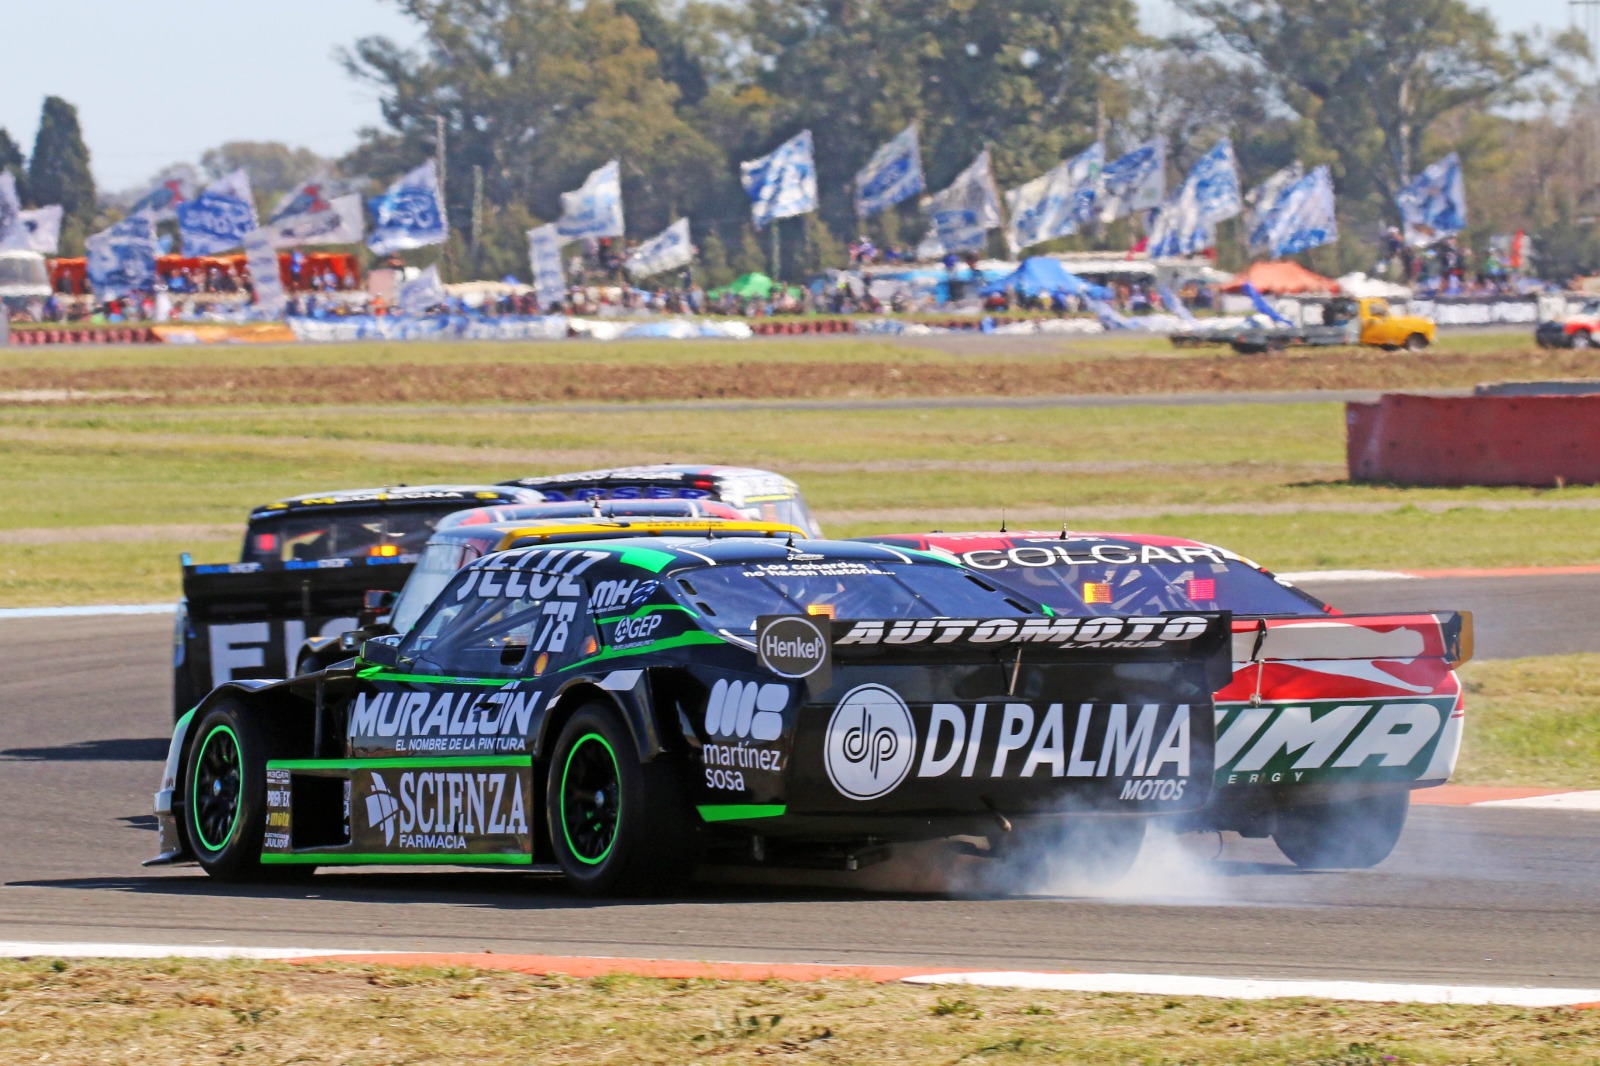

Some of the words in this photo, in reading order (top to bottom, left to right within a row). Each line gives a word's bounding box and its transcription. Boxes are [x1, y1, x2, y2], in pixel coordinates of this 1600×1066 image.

[756, 563, 789, 571] Los
[791, 561, 867, 571] cobardes
[962, 545, 1225, 570] COLCAR
[456, 549, 611, 601] JELUZ
[742, 570, 765, 578] no
[770, 568, 819, 577] hacen
[822, 567, 896, 577] historia...
[587, 578, 639, 608] MH
[533, 601, 577, 653] 78
[628, 614, 662, 639] GEP
[834, 617, 1208, 645] AUTOMOTO
[766, 634, 821, 659] Henkel
[1059, 641, 1167, 649] LANUS
[350, 681, 542, 737] MURALLÓN
[395, 740, 407, 751] EL
[408, 739, 448, 751] NOMBRE
[449, 739, 463, 750] DE
[463, 739, 476, 750] LA
[478, 738, 526, 750] PINTURA
[917, 702, 987, 778] DI
[991, 702, 1191, 779] PALMA
[1215, 703, 1441, 772] UMA
[703, 740, 781, 771] martínez
[705, 769, 746, 792] sosa
[1119, 778, 1187, 801] MOTOS
[1227, 772, 1304, 785] ERGY
[399, 772, 529, 836] SCIENZA
[399, 834, 467, 850] FARMACIA
